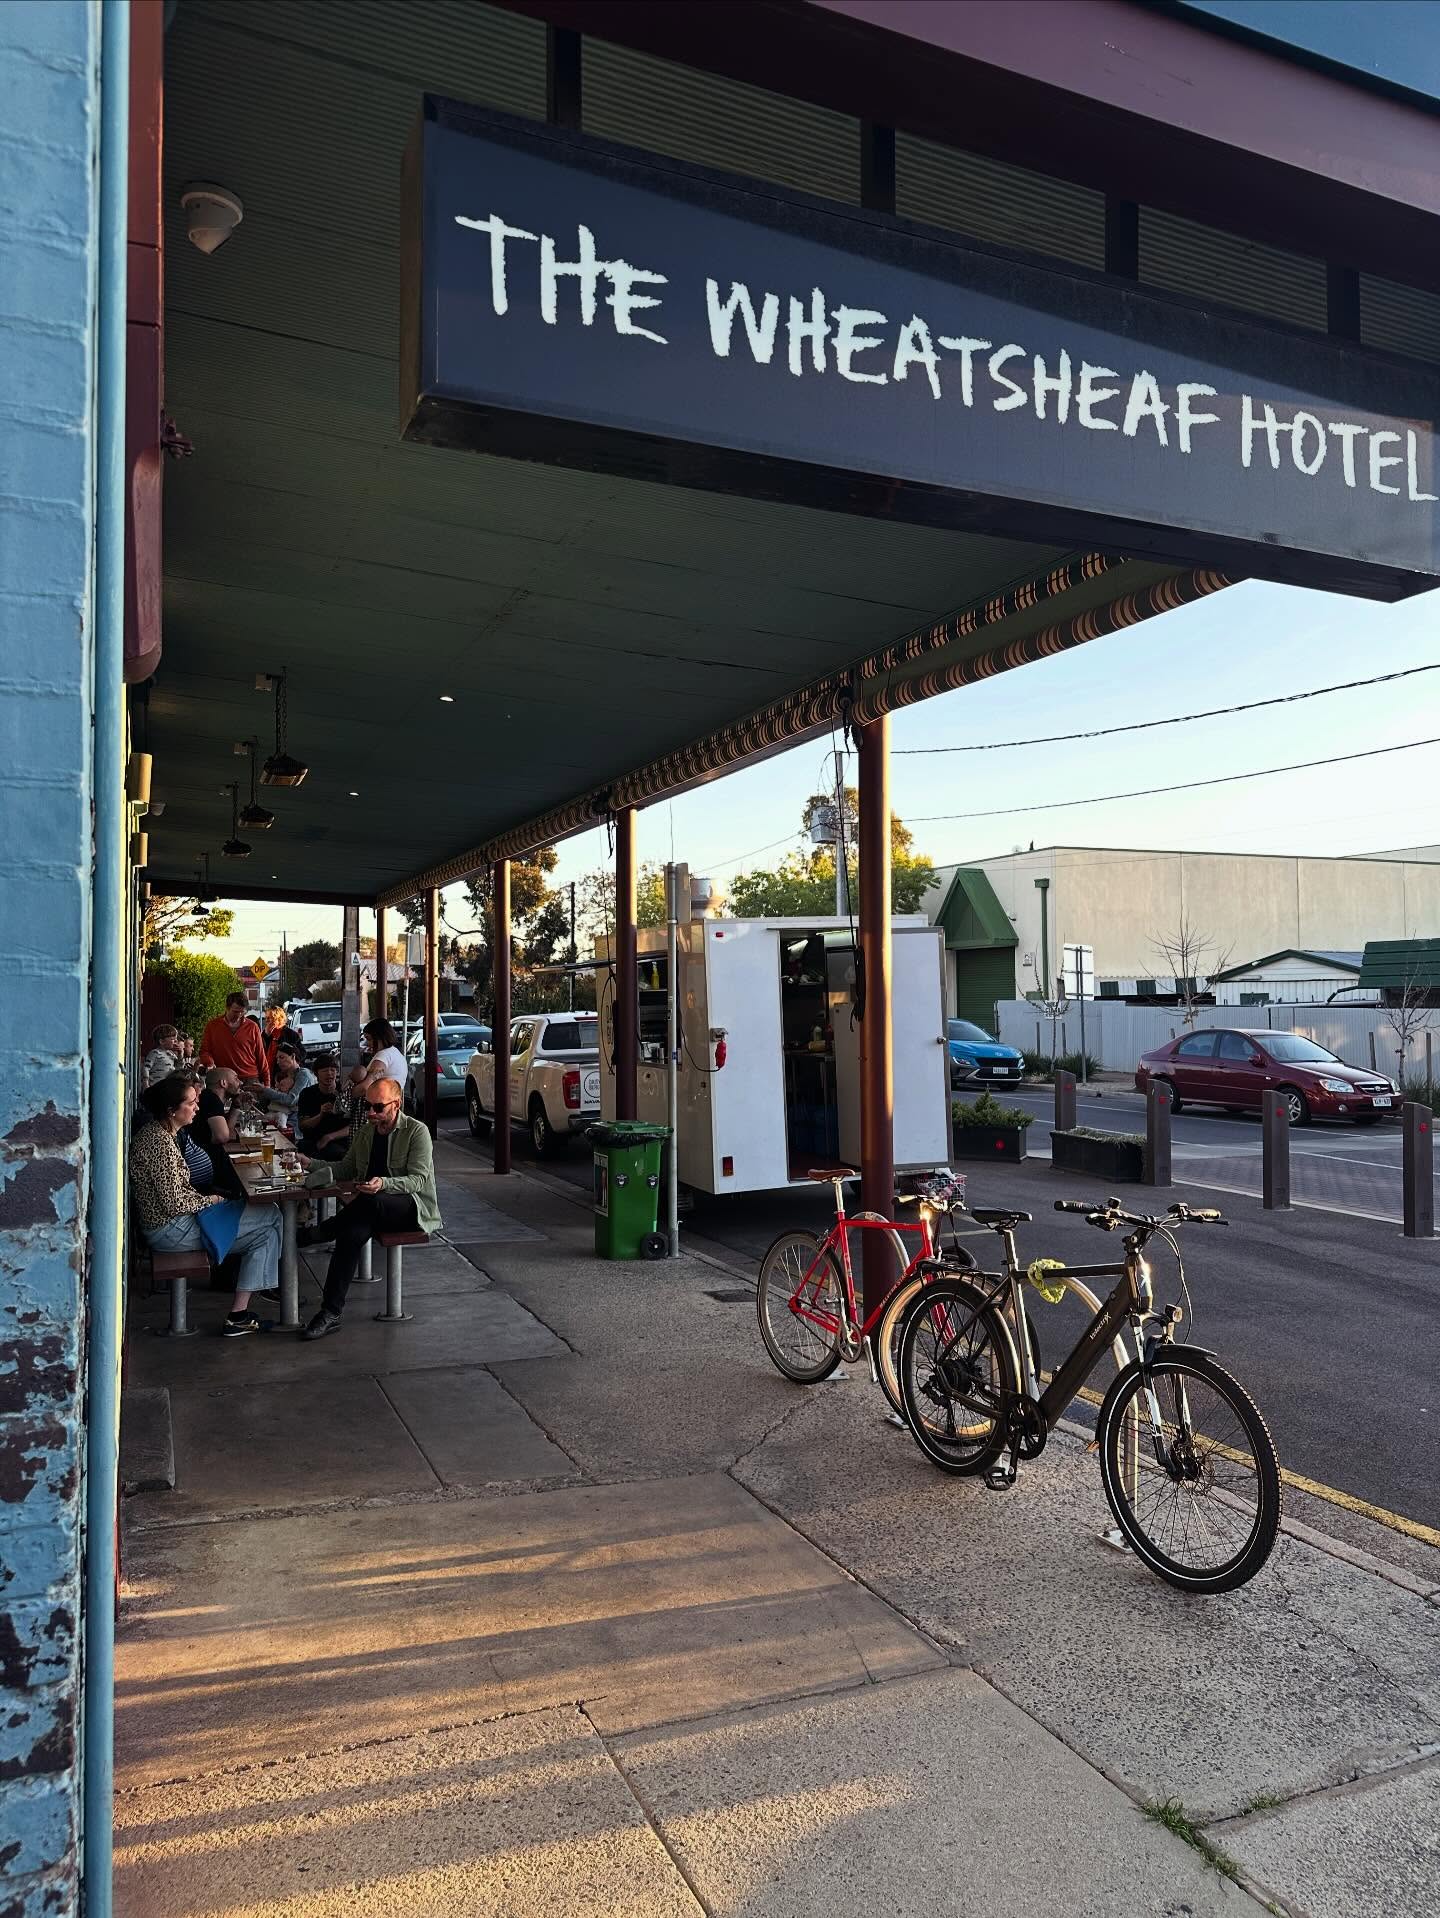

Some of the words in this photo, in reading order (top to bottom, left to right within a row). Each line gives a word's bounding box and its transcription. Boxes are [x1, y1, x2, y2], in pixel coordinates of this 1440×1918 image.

[455, 215, 668, 344] THE
[707, 279, 1221, 454] WHEATSHEAF
[1242, 395, 1440, 502] HOTEL
[254, 964, 266, 974] DIP
